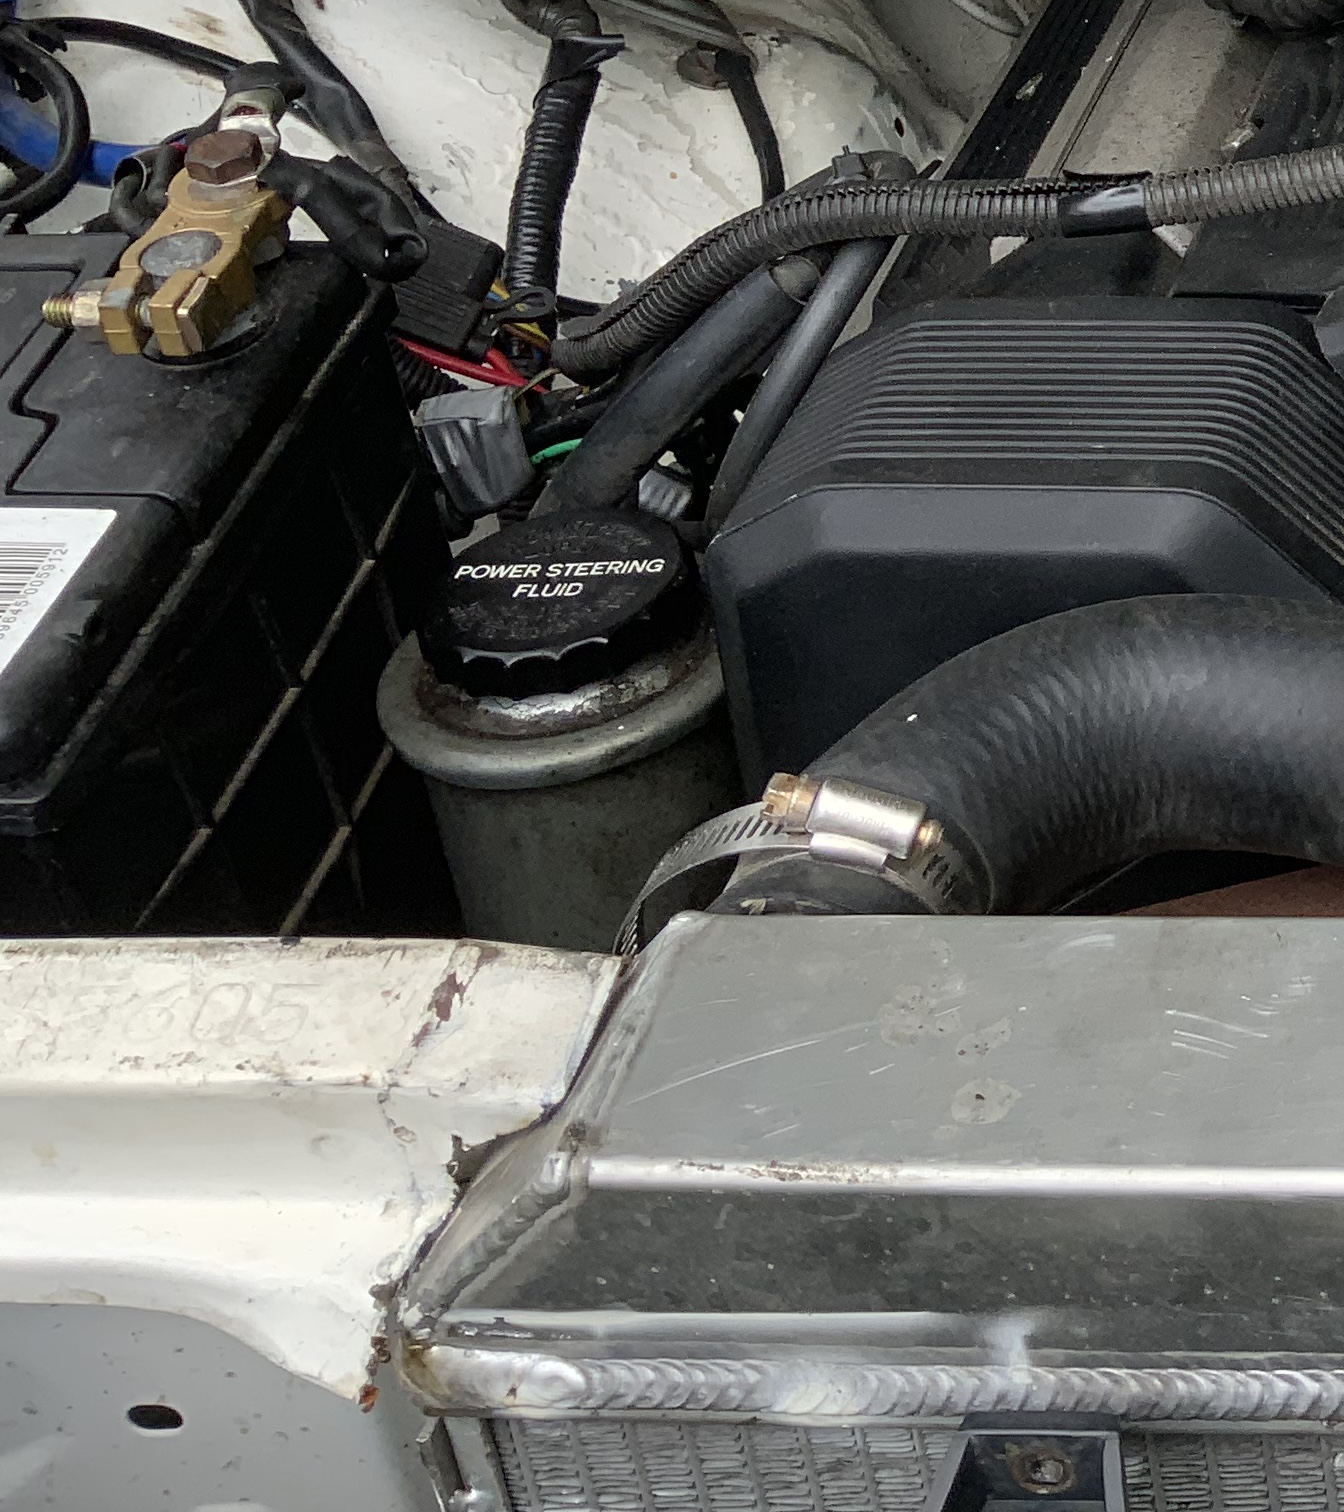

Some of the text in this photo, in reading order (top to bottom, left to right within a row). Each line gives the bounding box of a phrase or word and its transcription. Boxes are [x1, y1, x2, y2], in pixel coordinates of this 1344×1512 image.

[453, 557, 666, 581] POWER STEERING
[512, 581, 584, 599] FLUID
